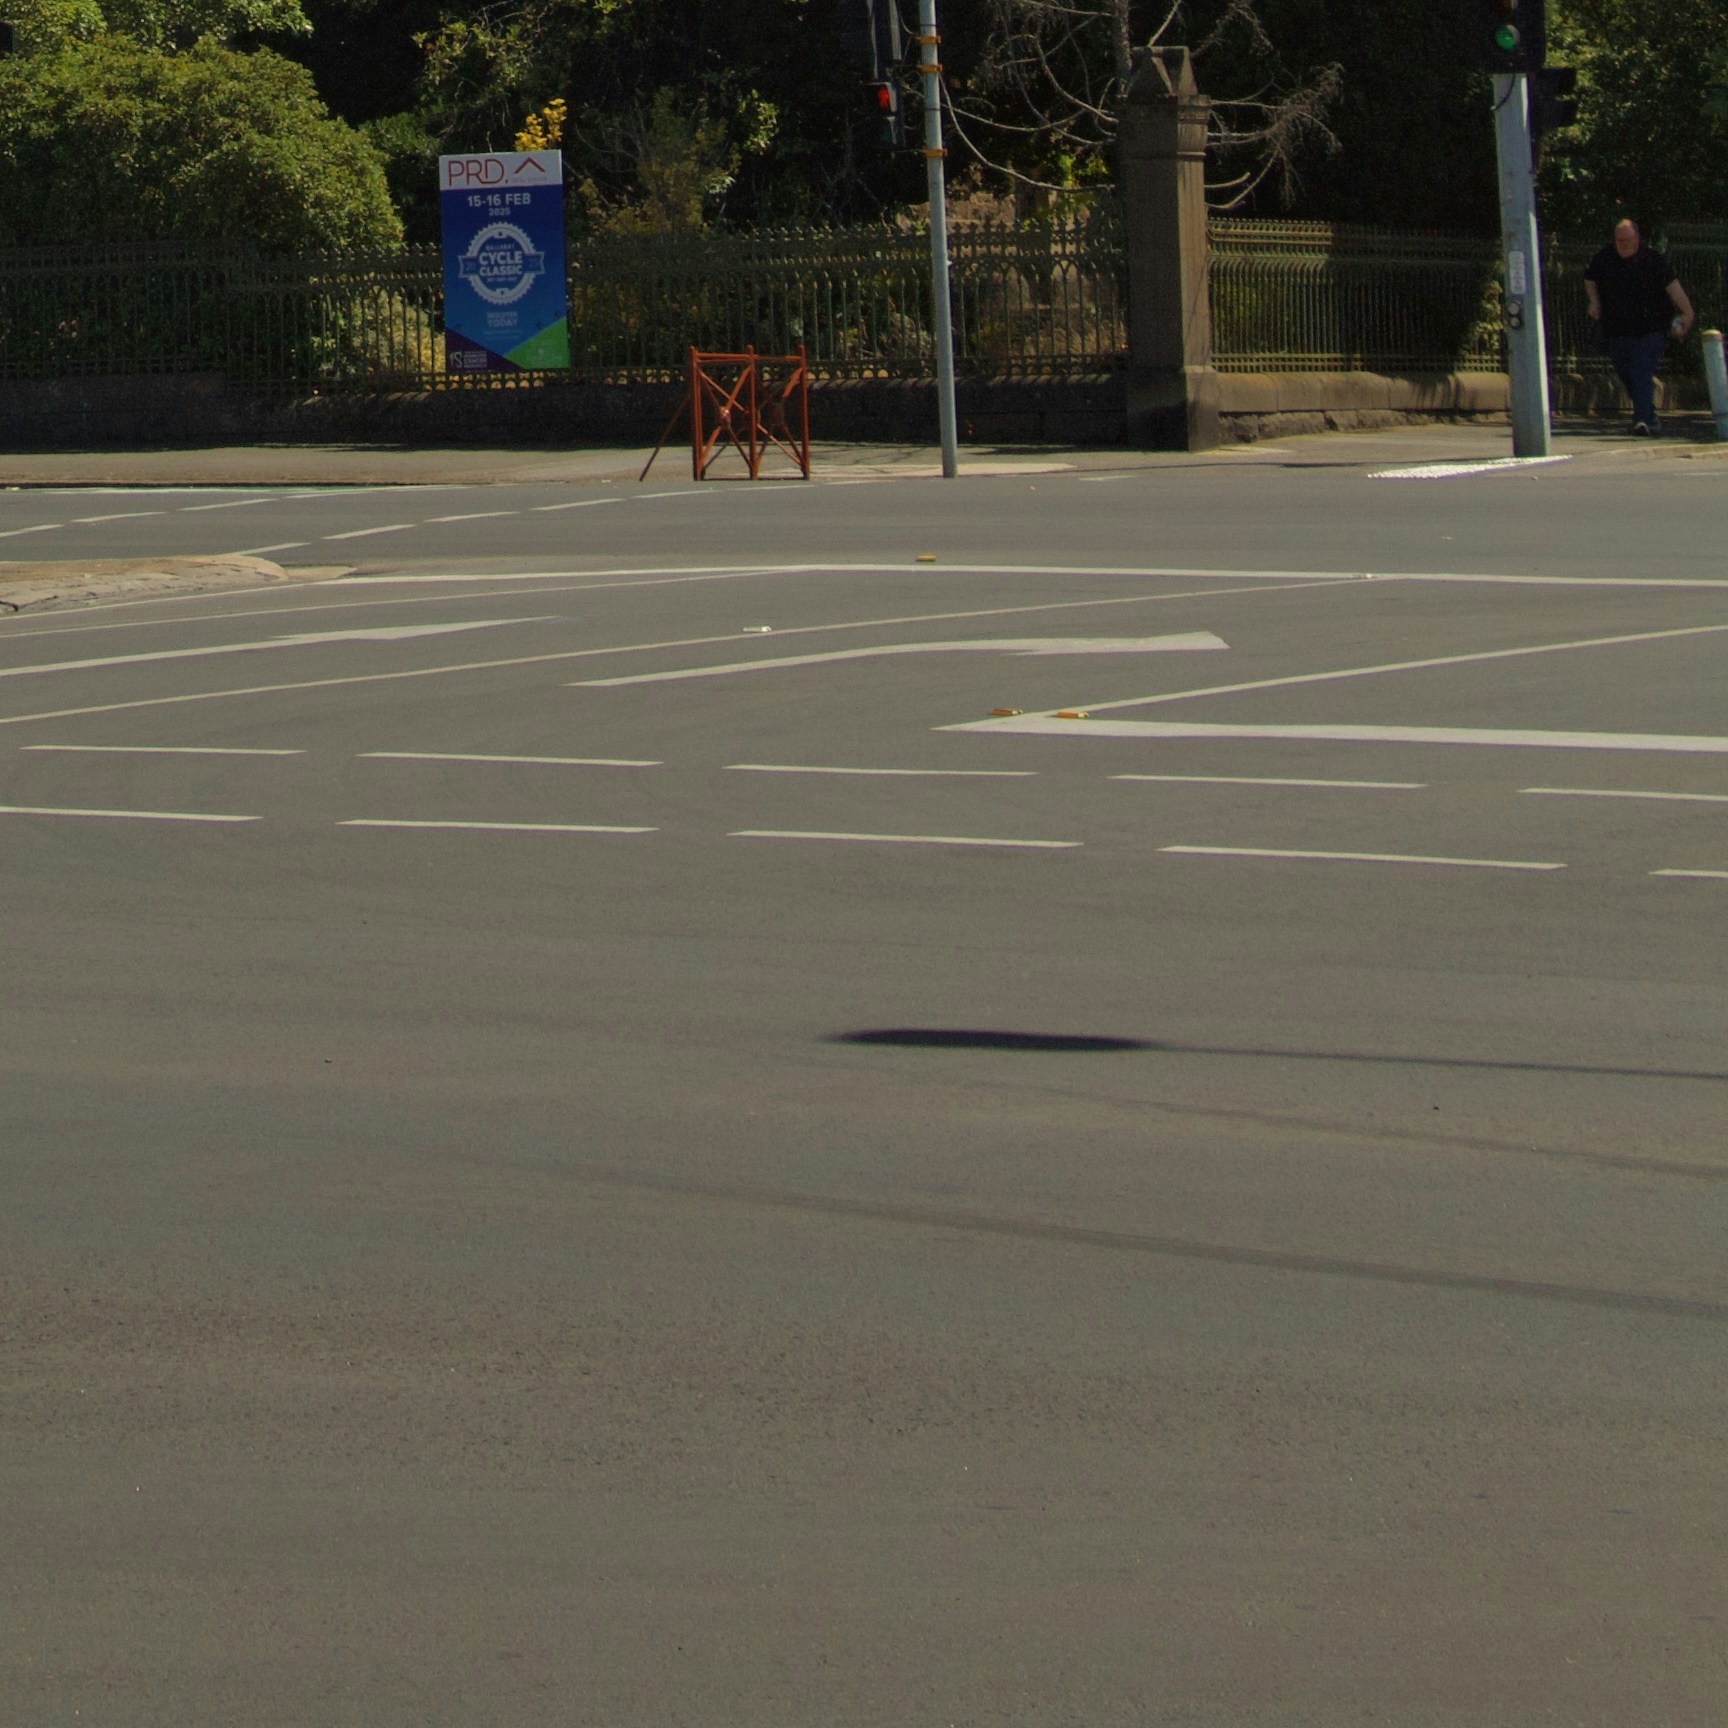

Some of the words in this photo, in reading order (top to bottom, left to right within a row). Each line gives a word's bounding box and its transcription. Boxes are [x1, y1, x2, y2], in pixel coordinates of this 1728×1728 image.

[467, 193, 502, 208] 15-16
[505, 192, 532, 205] FEB
[488, 207, 511, 217] 2025
[479, 250, 524, 266] CYCLE
[479, 264, 524, 277] CLASSIC
[487, 318, 519, 328] TODAY
